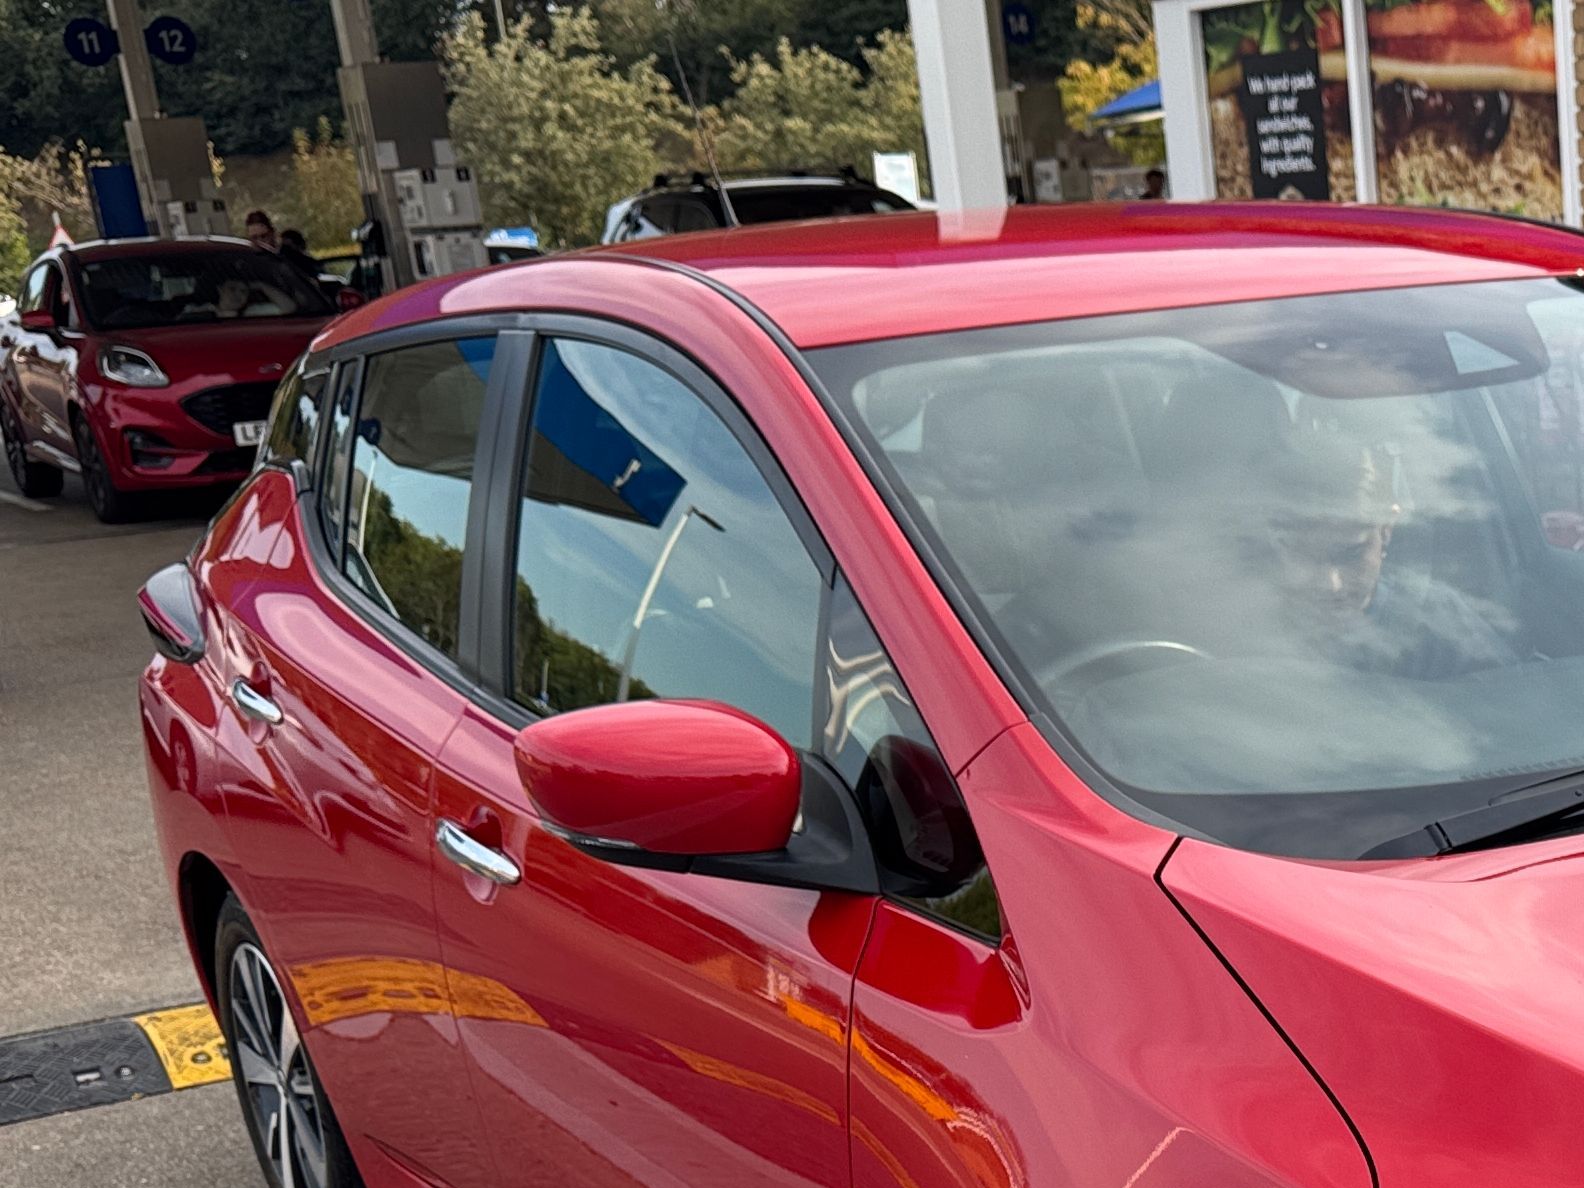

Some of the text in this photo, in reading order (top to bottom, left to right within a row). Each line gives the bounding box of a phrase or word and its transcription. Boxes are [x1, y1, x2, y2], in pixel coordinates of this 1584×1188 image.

[1008, 13, 1029, 35] 14
[77, 31, 101, 54] 11
[158, 29, 187, 53] 12
[1290, 69, 1317, 96] pack
